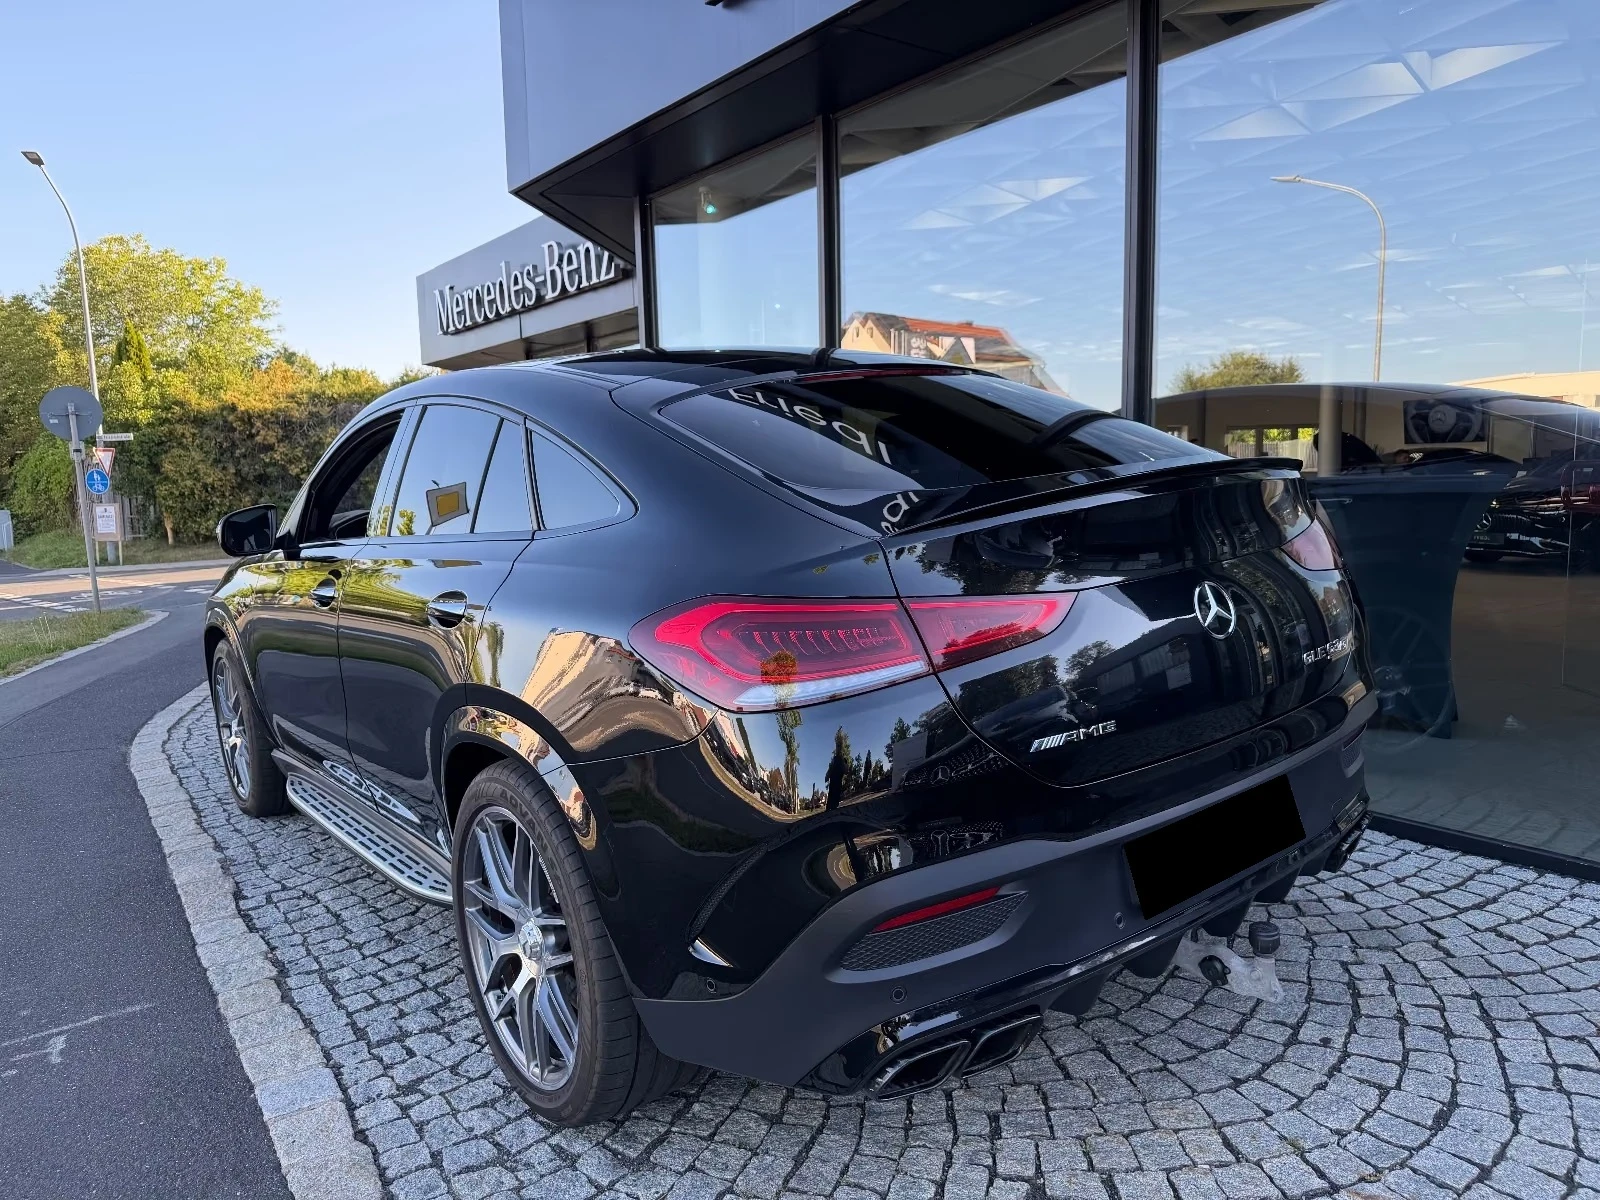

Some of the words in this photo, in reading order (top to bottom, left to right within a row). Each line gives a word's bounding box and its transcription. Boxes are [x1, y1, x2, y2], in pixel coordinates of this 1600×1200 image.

[433, 240, 616, 336] Mercedes-Benz
[1303, 645, 1327, 665] GLE
[1058, 720, 1116, 747] AMG
[500, 788, 549, 853] ADVAN
